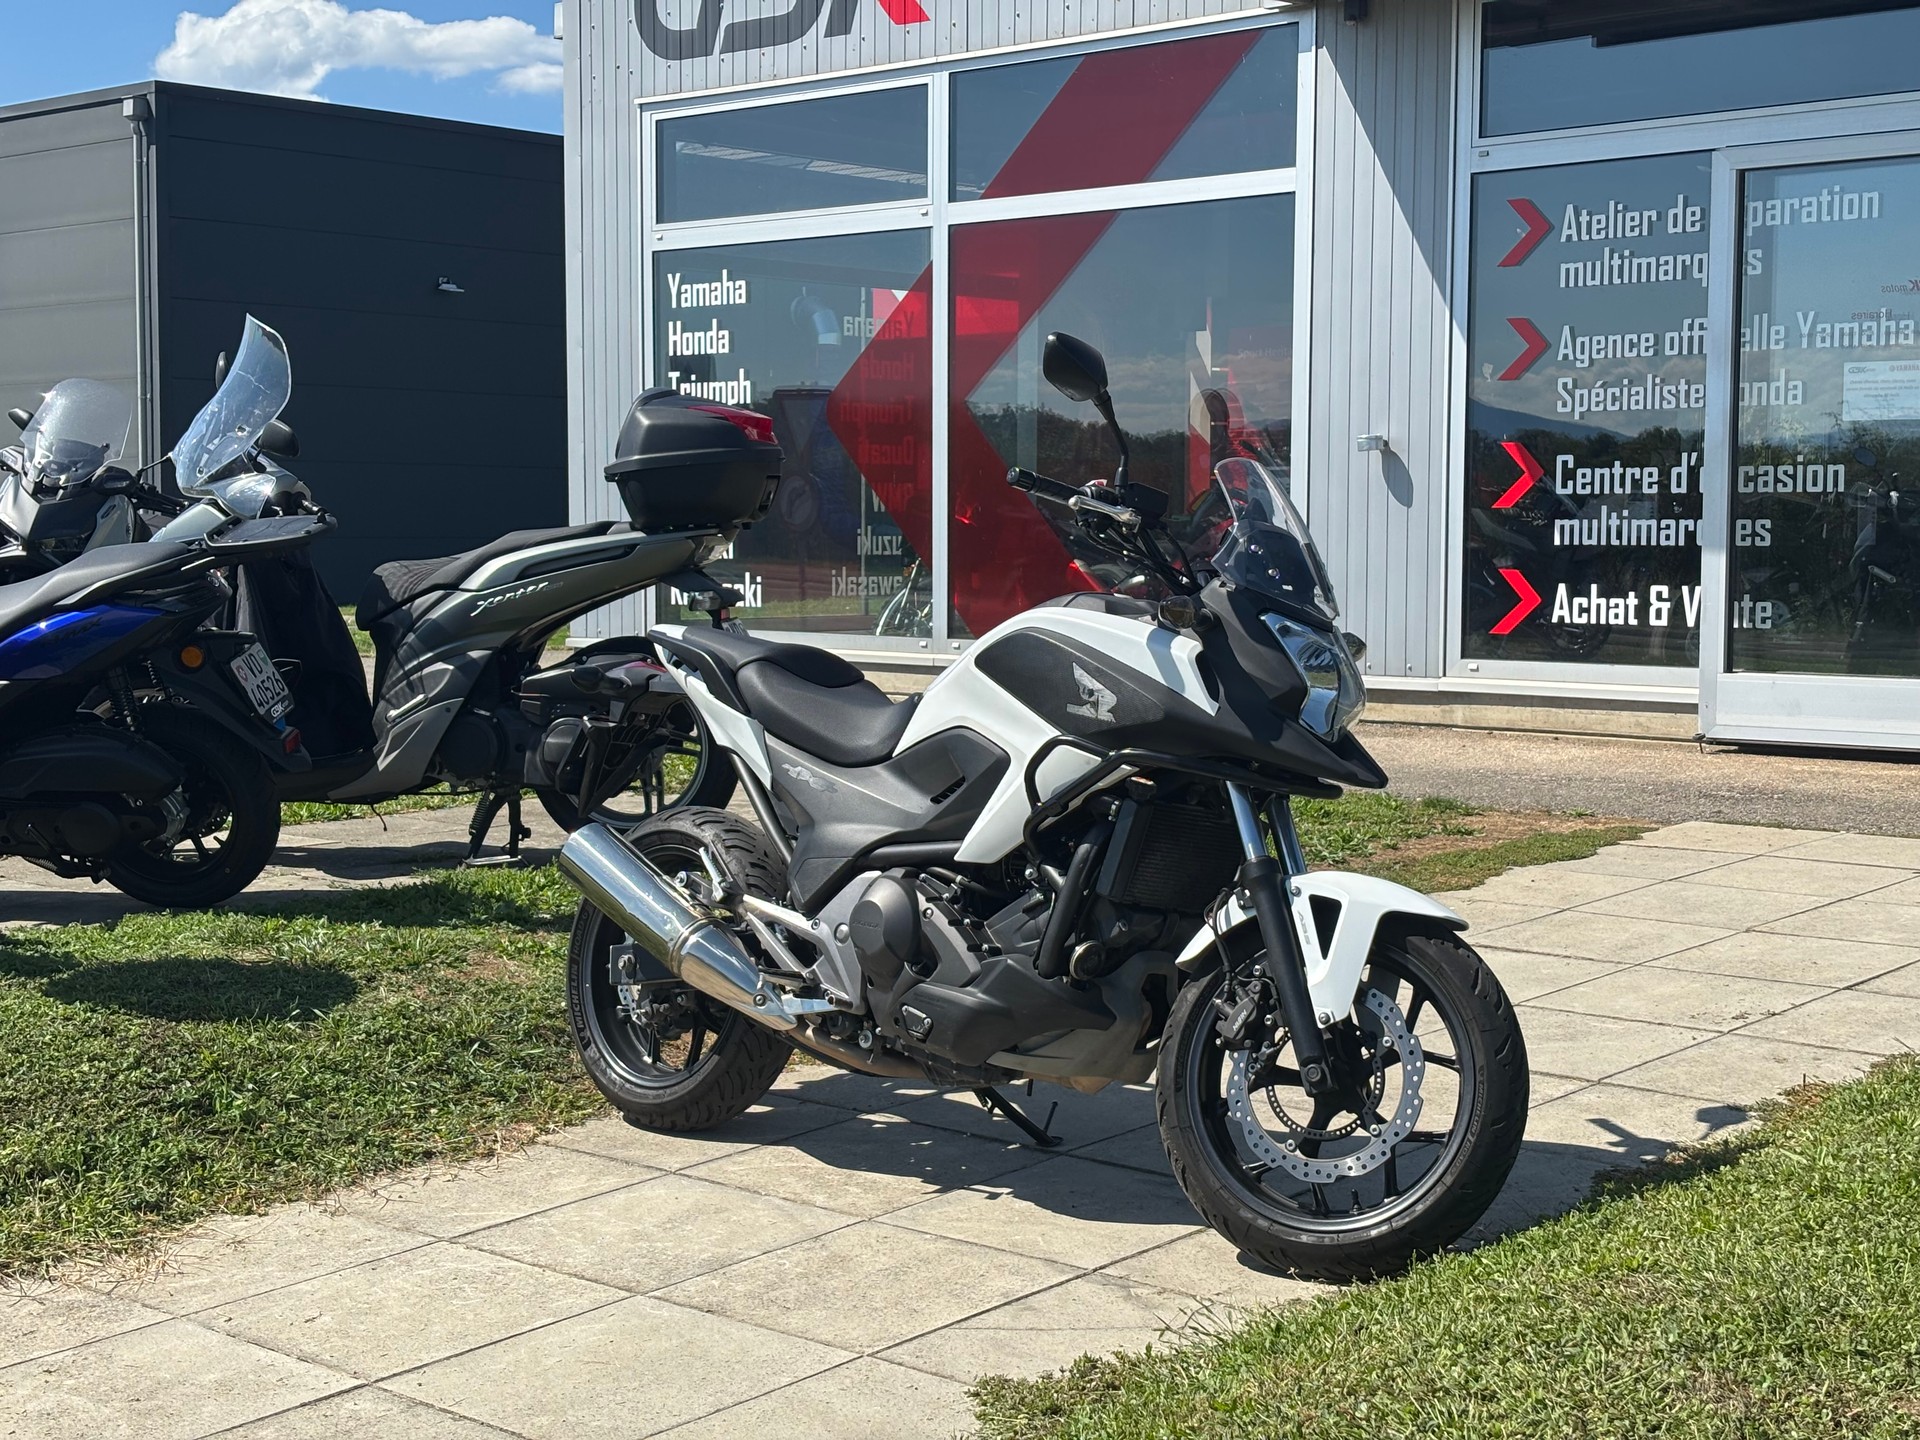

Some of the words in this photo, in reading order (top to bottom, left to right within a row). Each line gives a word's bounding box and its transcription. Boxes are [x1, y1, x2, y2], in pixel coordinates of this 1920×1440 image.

[1560, 200, 1657, 242] Atelier
[1668, 193, 1701, 234] de
[1746, 184, 1880, 236] paration
[1560, 246, 1762, 288] multimarqs
[667, 268, 746, 309] Yamaha
[668, 318, 729, 357] Honda
[1557, 325, 1655, 368] Agence
[1796, 307, 1915, 349] Yamaha
[1557, 373, 1705, 420] Spécialiste
[1740, 368, 1803, 406] onda
[1556, 454, 1659, 494] Centre
[1554, 505, 1771, 547] multimares
[1551, 583, 1638, 626] Achat
[1649, 585, 1671, 627] &
[1681, 585, 1773, 629] Vte
[241, 653, 263, 679] VD
[250, 671, 285, 709] 40526
[570, 963, 584, 1028] MICHELIN
